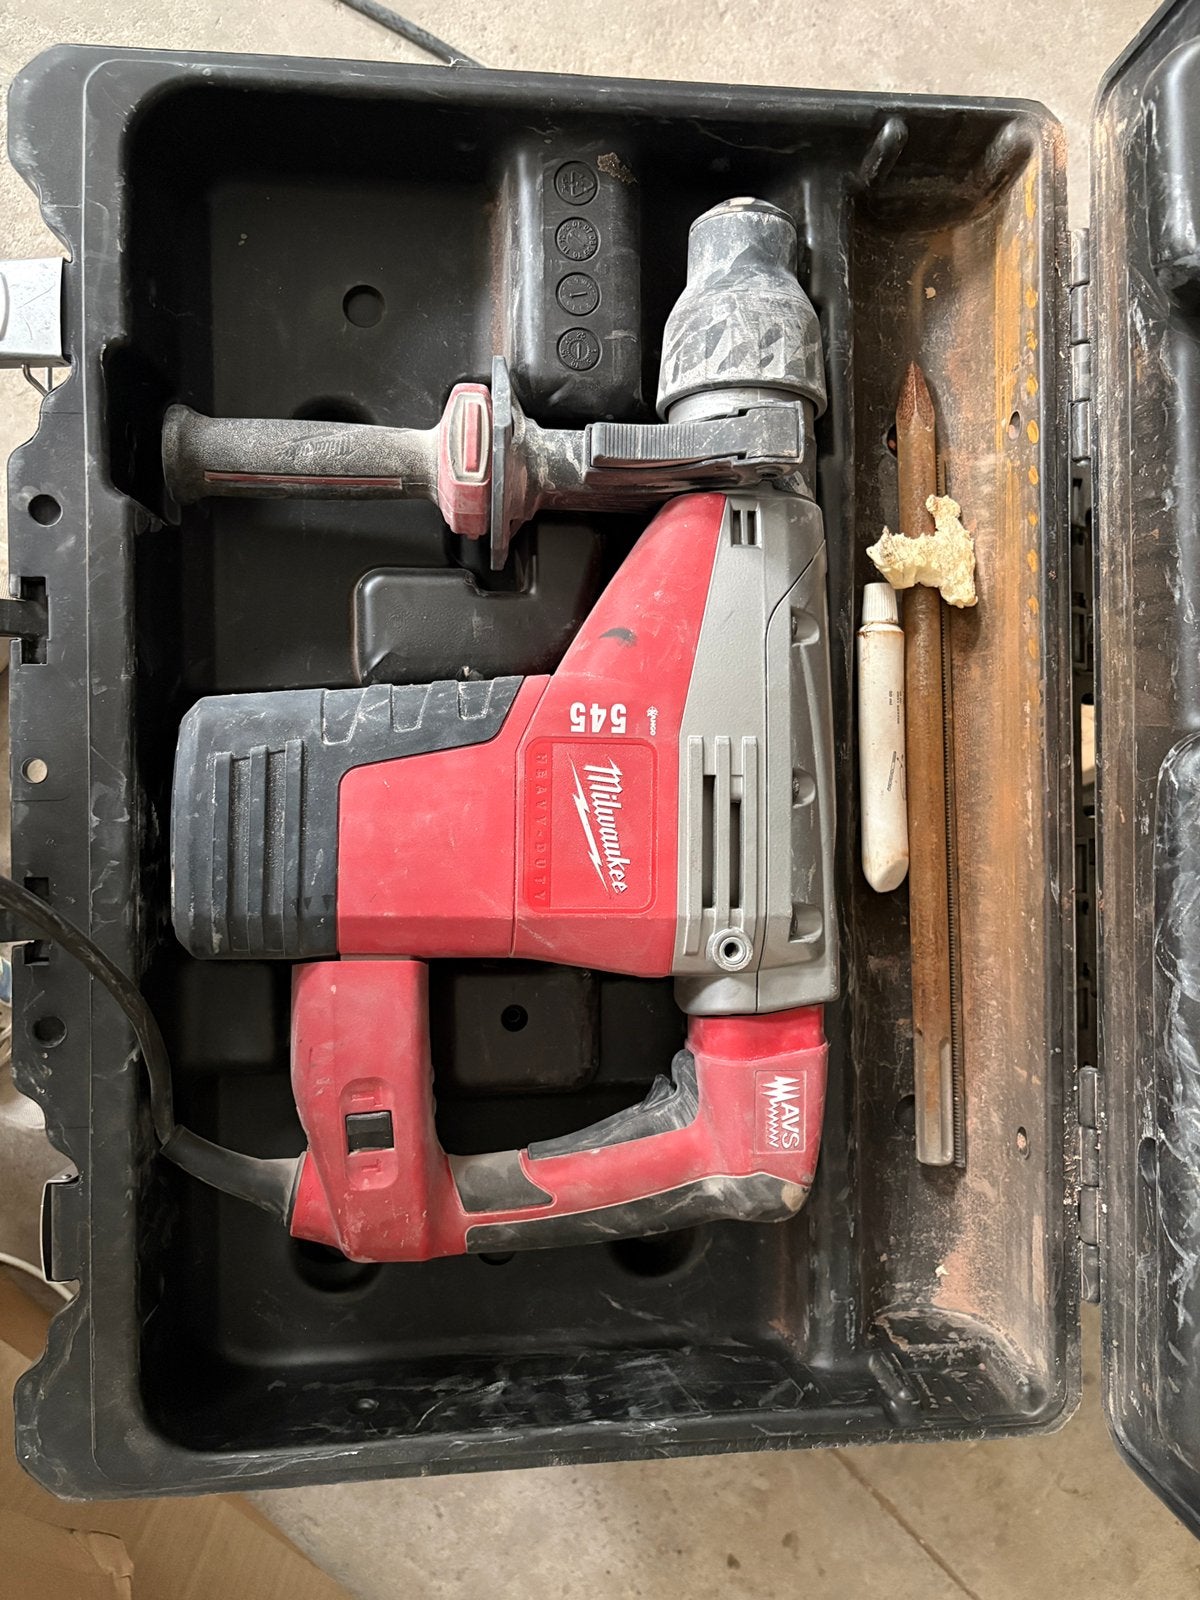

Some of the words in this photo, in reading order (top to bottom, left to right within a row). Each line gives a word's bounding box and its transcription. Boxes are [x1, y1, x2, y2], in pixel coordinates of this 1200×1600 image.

[569, 701, 627, 734] 545
[534, 752, 548, 901] HEAVY-DUTY
[583, 754, 631, 894] Milwaukee
[781, 1102, 800, 1149] AVS
